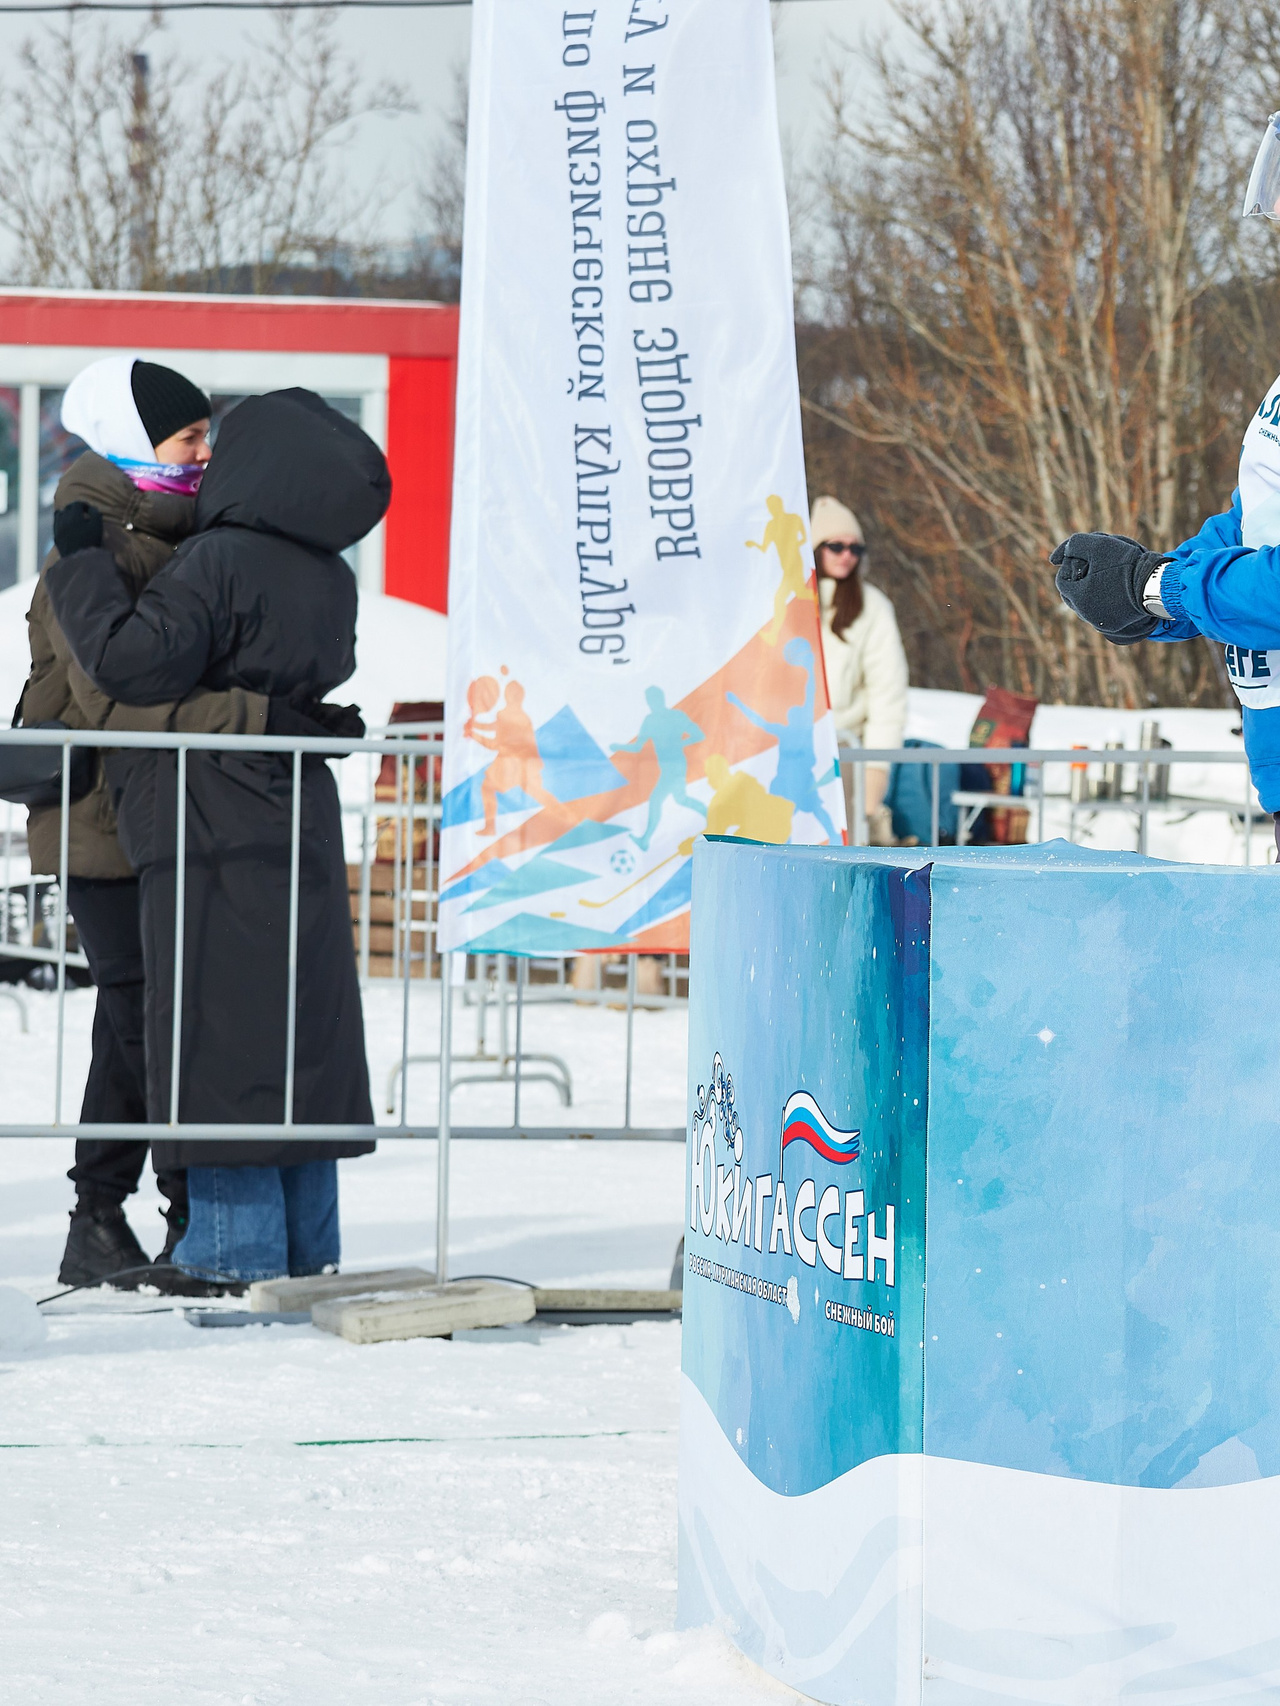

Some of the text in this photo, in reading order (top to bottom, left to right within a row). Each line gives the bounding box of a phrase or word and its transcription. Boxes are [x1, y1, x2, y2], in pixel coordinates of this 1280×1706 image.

[712, 1262, 757, 1297] МУРМАНСКАЯ
[757, 1278, 788, 1308] ОБЛАСТ
[825, 1299, 895, 1338] СНЕЖНЫЙ БОЙ
